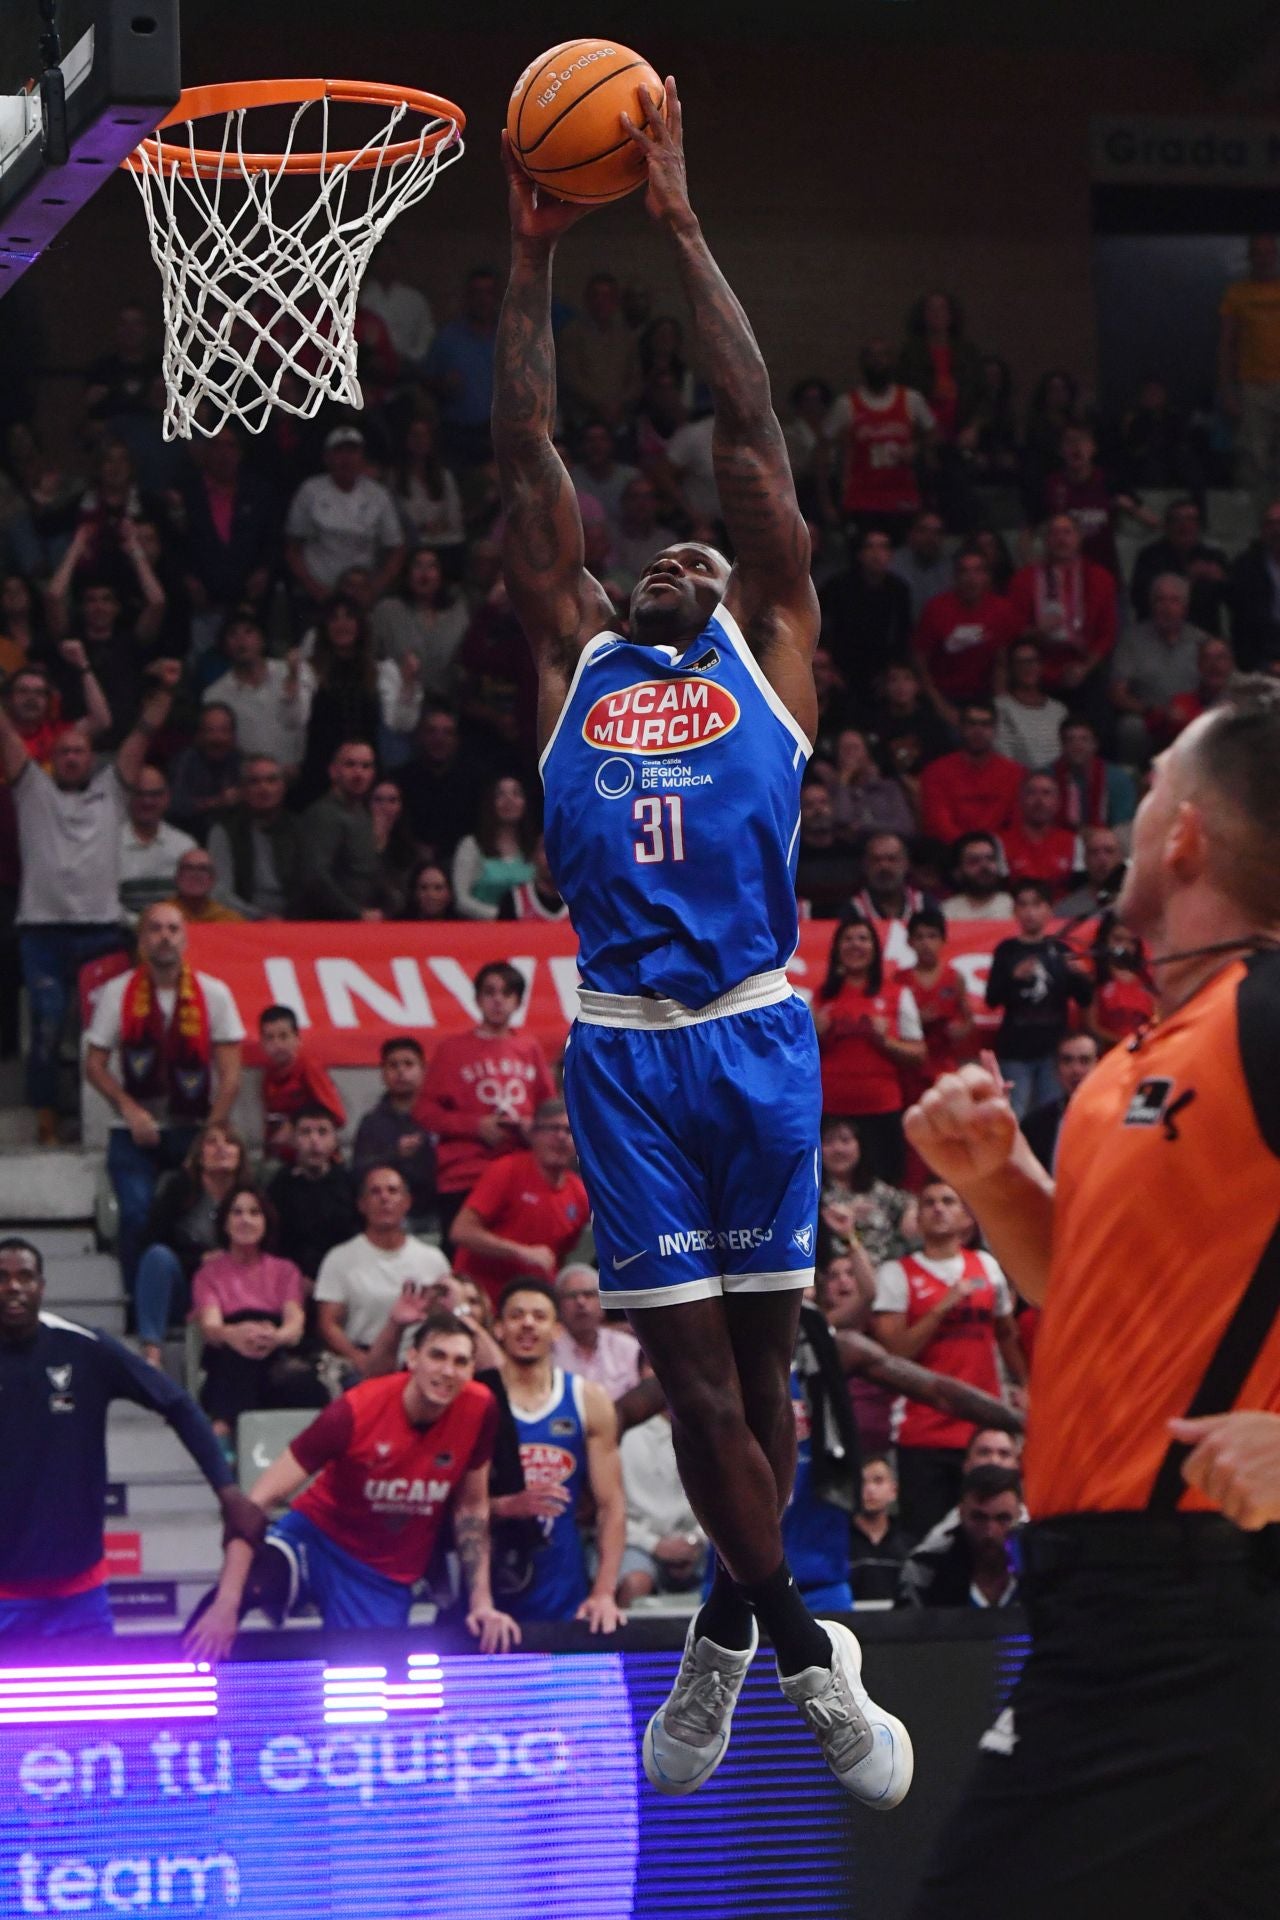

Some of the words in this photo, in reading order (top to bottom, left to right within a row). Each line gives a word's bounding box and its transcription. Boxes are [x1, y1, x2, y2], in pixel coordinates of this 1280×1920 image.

[608, 683, 709, 718] UCAM
[593, 712, 725, 747] MURCIA
[641, 765, 692, 778] REGIÓN
[641, 778, 658, 789] DE
[662, 774, 713, 788] MURCIA
[633, 794, 685, 864] 31
[519, 1446, 563, 1466] CAM
[364, 1478, 451, 1503] UCAM
[19, 1741, 126, 1800] en
[150, 1732, 233, 1796] tu
[259, 1727, 570, 1804] equipo
[16, 1852, 241, 1912] team
